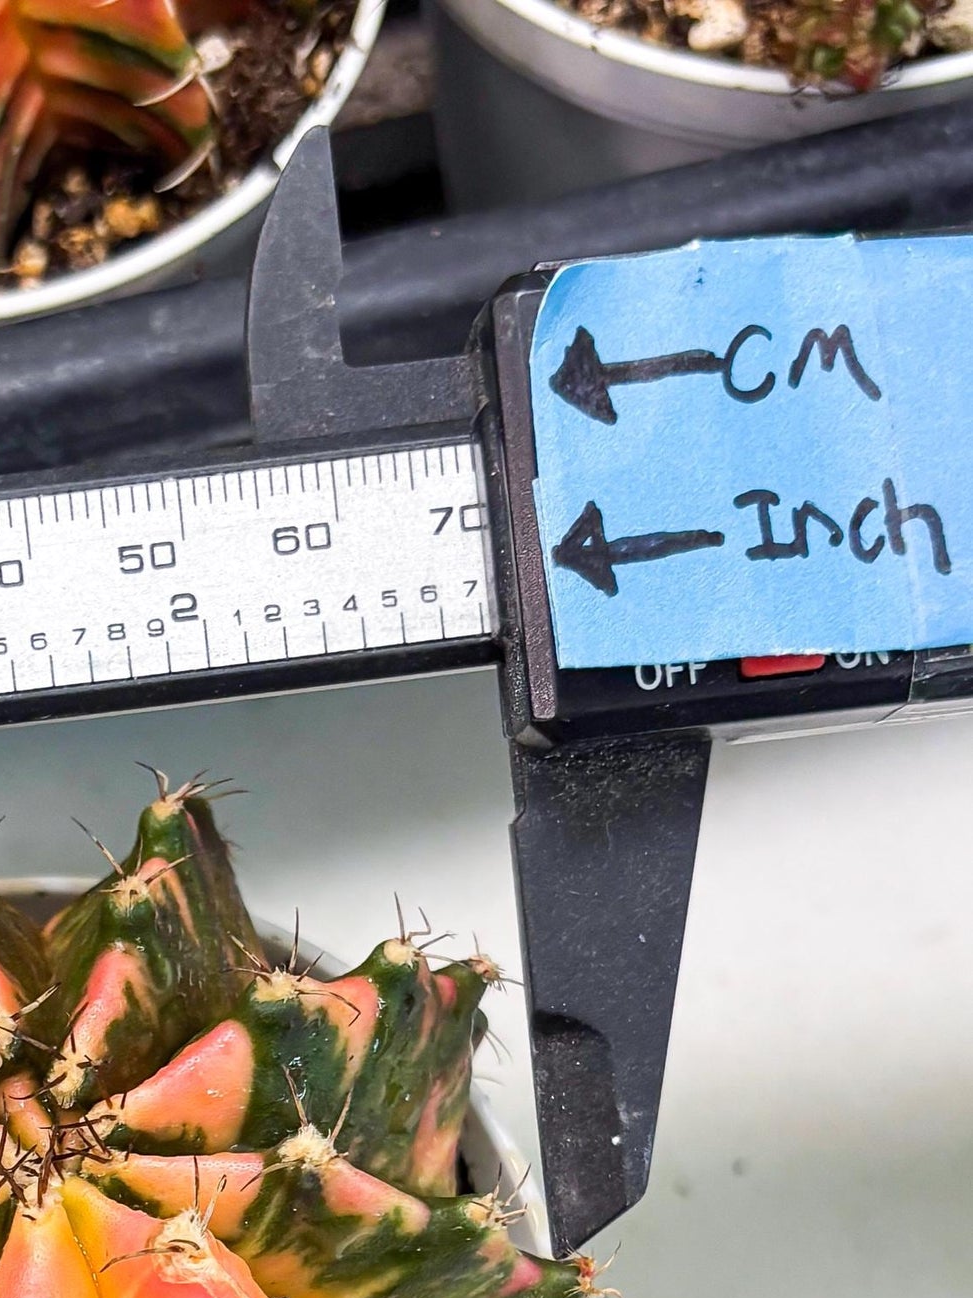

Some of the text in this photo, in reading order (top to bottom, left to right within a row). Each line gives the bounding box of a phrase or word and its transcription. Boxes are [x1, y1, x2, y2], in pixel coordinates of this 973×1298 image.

[118, 542, 176, 574] 50
[272, 522, 332, 556] 60
[429, 502, 486, 536] 70
[732, 477, 953, 576] Inch
[30, 632, 48, 651] 6
[72, 627, 87, 646] 7
[107, 622, 126, 641] 8
[146, 618, 165, 638] 9
[170, 592, 199, 622] 2
[233, 609, 242, 626] 1
[264, 604, 282, 623] 2
[303, 599, 321, 616] 3
[342, 594, 358, 612] 4
[381, 589, 398, 608] 5
[420, 584, 438, 603] 6
[463, 579, 477, 597] 7
[634, 661, 707, 691] OFF
